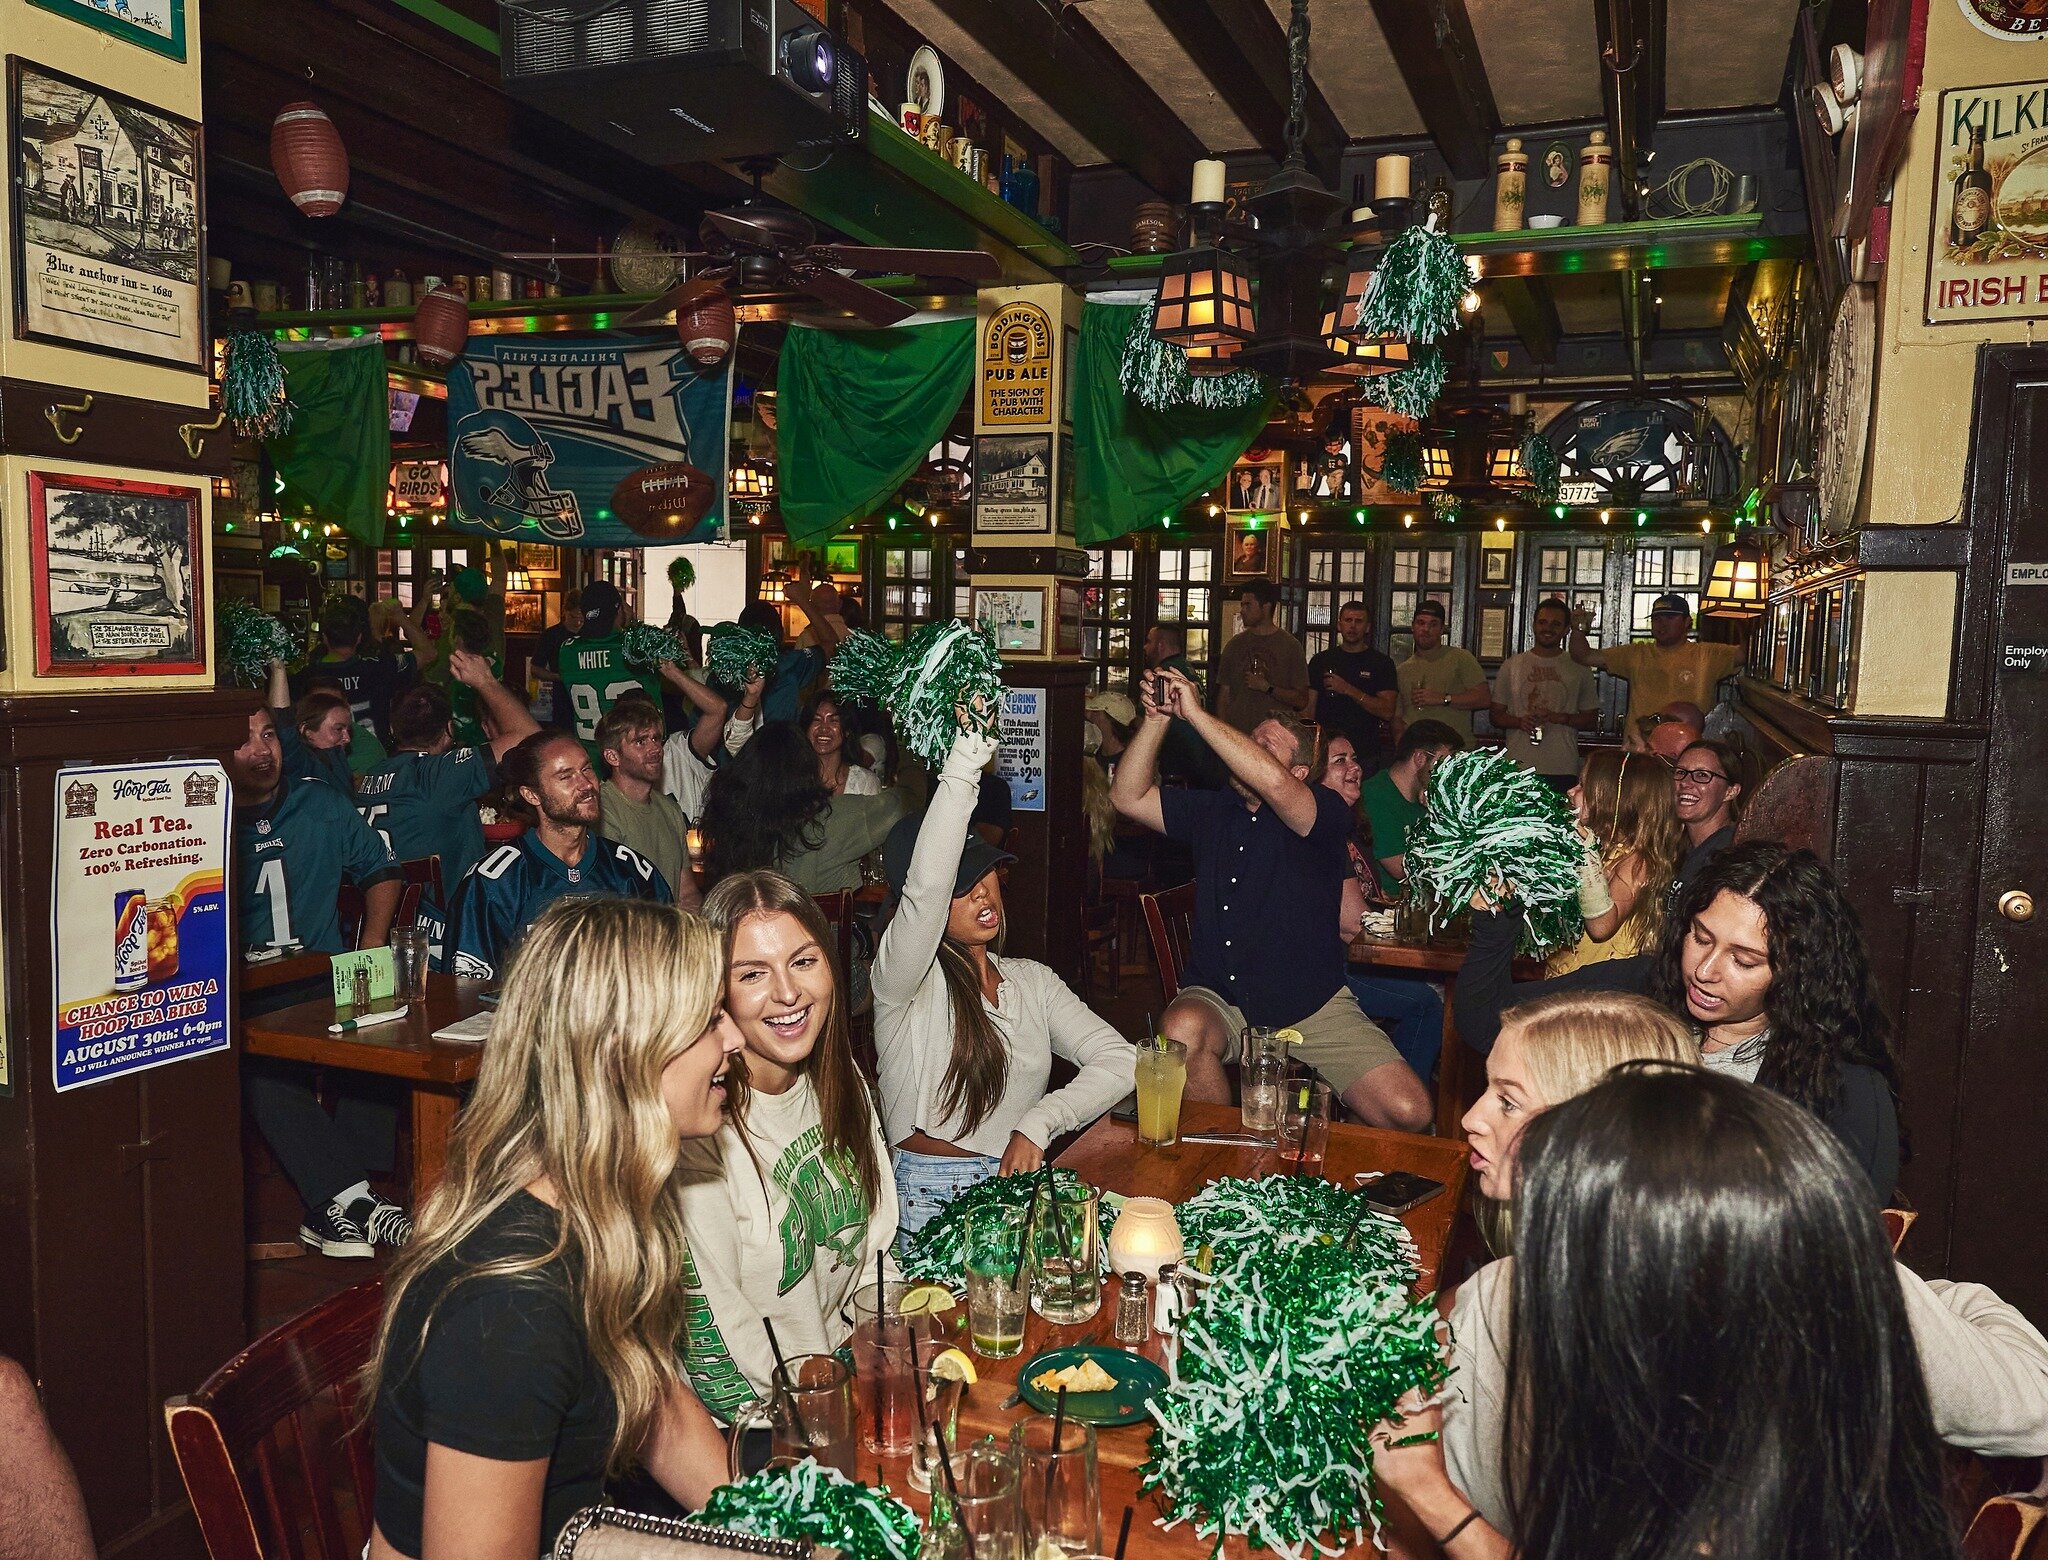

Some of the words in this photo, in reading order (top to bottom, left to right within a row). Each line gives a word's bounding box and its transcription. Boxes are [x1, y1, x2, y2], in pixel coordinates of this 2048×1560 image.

[2008, 17, 2048, 32] BE
[45, 252, 74, 274] Blue
[79, 266, 119, 286] anchor
[121, 274, 138, 290] inn
[152, 284, 173, 299] 1680
[1938, 276, 2028, 309] IRISH
[990, 312, 1045, 350] BODDINGTONS
[986, 369, 1015, 381] PUB
[1020, 367, 1049, 380] ALE
[990, 389, 1006, 398] THE
[1008, 388, 1030, 398] SIGN
[1032, 387, 1045, 397] OF
[991, 399, 998, 407] A
[1000, 398, 1018, 407] PUB
[1020, 397, 1044, 406] WITH
[992, 407, 1044, 416] CHARACTER
[408, 466, 431, 480] GO
[398, 481, 439, 496] BIRDS
[578, 650, 611, 670] WHITE
[2004, 657, 2031, 669] Only
[338, 676, 360, 690] OY
[1012, 694, 1037, 704] DRINK
[1011, 704, 1037, 715] ENJOY
[1003, 719, 1016, 727] 17th
[1016, 719, 1039, 728] Annual
[1024, 728, 1040, 737] MUG
[1006, 738, 1035, 747] SUNDAY
[113, 779, 147, 801] Hoop
[147, 778, 171, 797] Tea
[94, 817, 144, 840] Real
[149, 815, 193, 834] Tea.
[79, 846, 113, 860] Zero
[117, 836, 207, 856] Carbonation.
[254, 838, 284, 853] EAGLES
[84, 861, 121, 876] 100%
[124, 852, 203, 872] Refreshing.
[193, 905, 203, 914] 5%
[204, 904, 219, 913] ABV.
[254, 859, 300, 947] 1
[66, 994, 140, 1024] CHANCE
[140, 990, 166, 1008] TO
[168, 981, 203, 1002] WIN
[205, 979, 219, 994] A
[79, 1016, 129, 1041] HOOP
[131, 1010, 164, 1030] TEA
[166, 999, 207, 1022] BIKE
[62, 1034, 139, 1066] AUGUST
[143, 1028, 179, 1047] 30th:
[182, 1020, 223, 1037] 6-9pm
[74, 1065, 87, 1075] DJ
[88, 1060, 109, 1071] WILL
[109, 1049, 153, 1066] ANNOUNCE
[154, 1042, 185, 1055] WINNER
[185, 1037, 197, 1046] AT
[196, 1036, 212, 1045] 9pm
